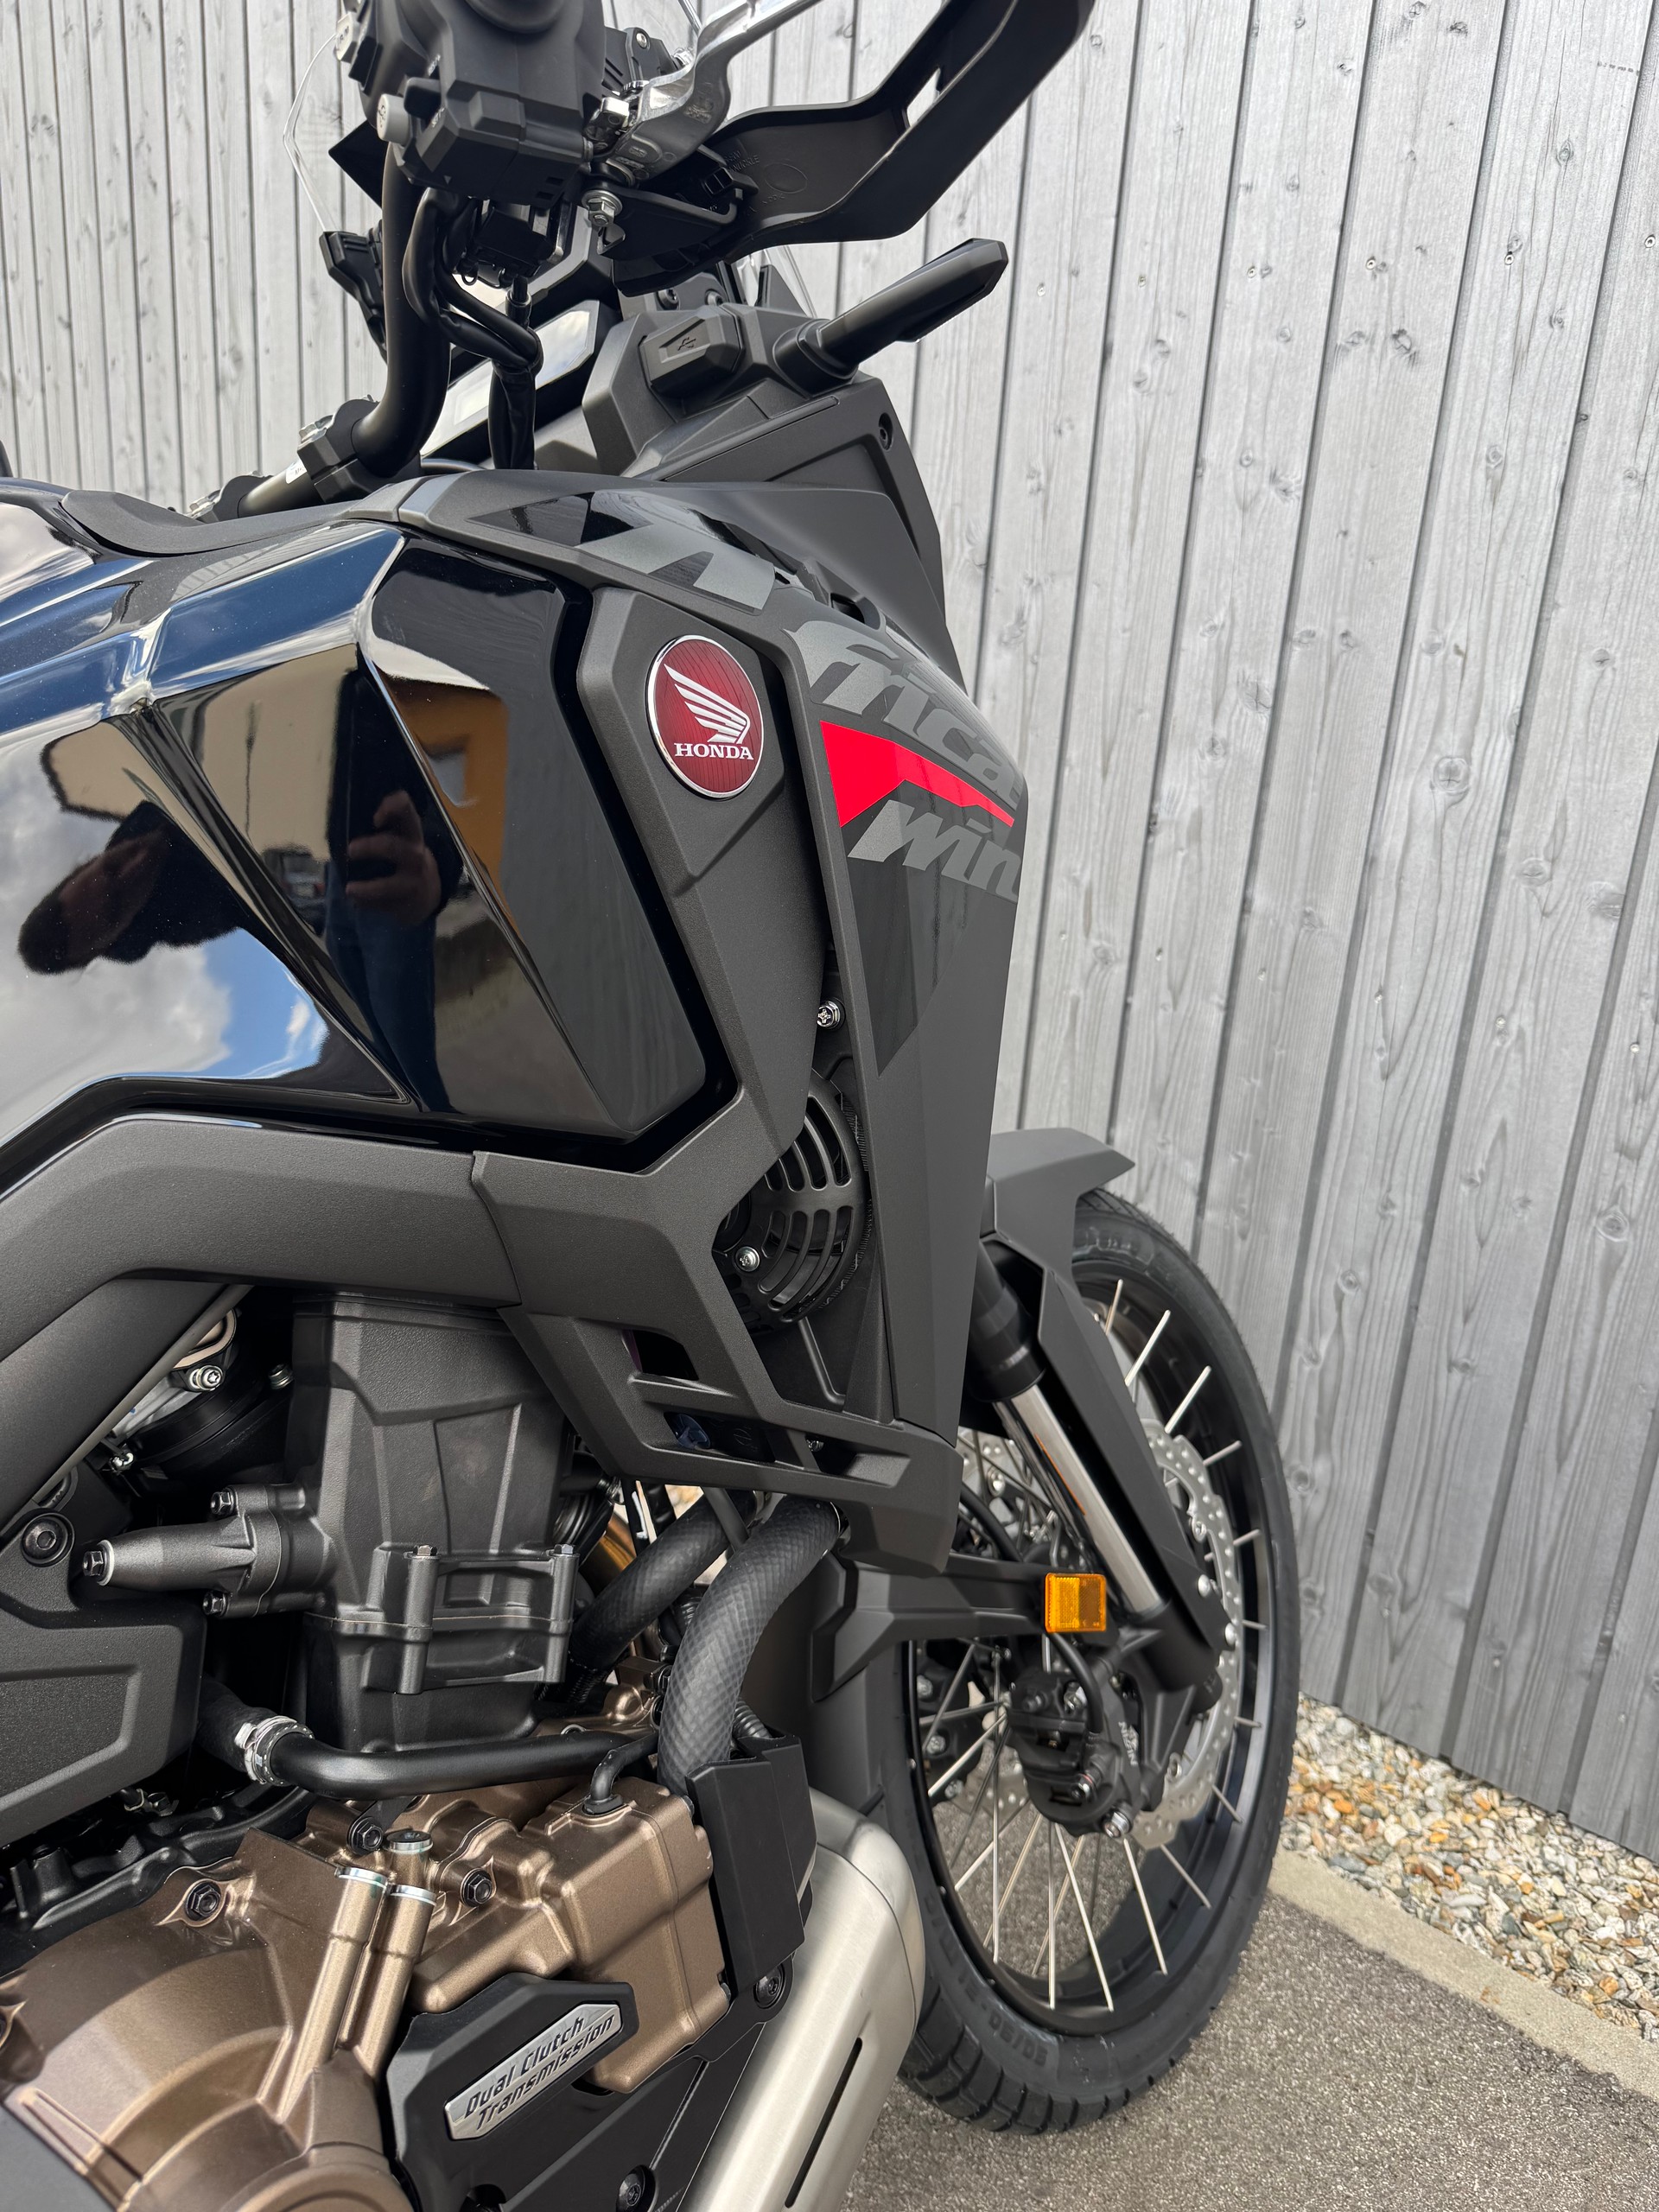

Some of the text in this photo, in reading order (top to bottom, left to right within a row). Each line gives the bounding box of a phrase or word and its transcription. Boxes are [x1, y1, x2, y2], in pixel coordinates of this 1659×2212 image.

[673, 742, 754, 760] HONDA
[463, 2016, 585, 2120] Dual Clutch
[475, 2013, 615, 2131] Transmission
